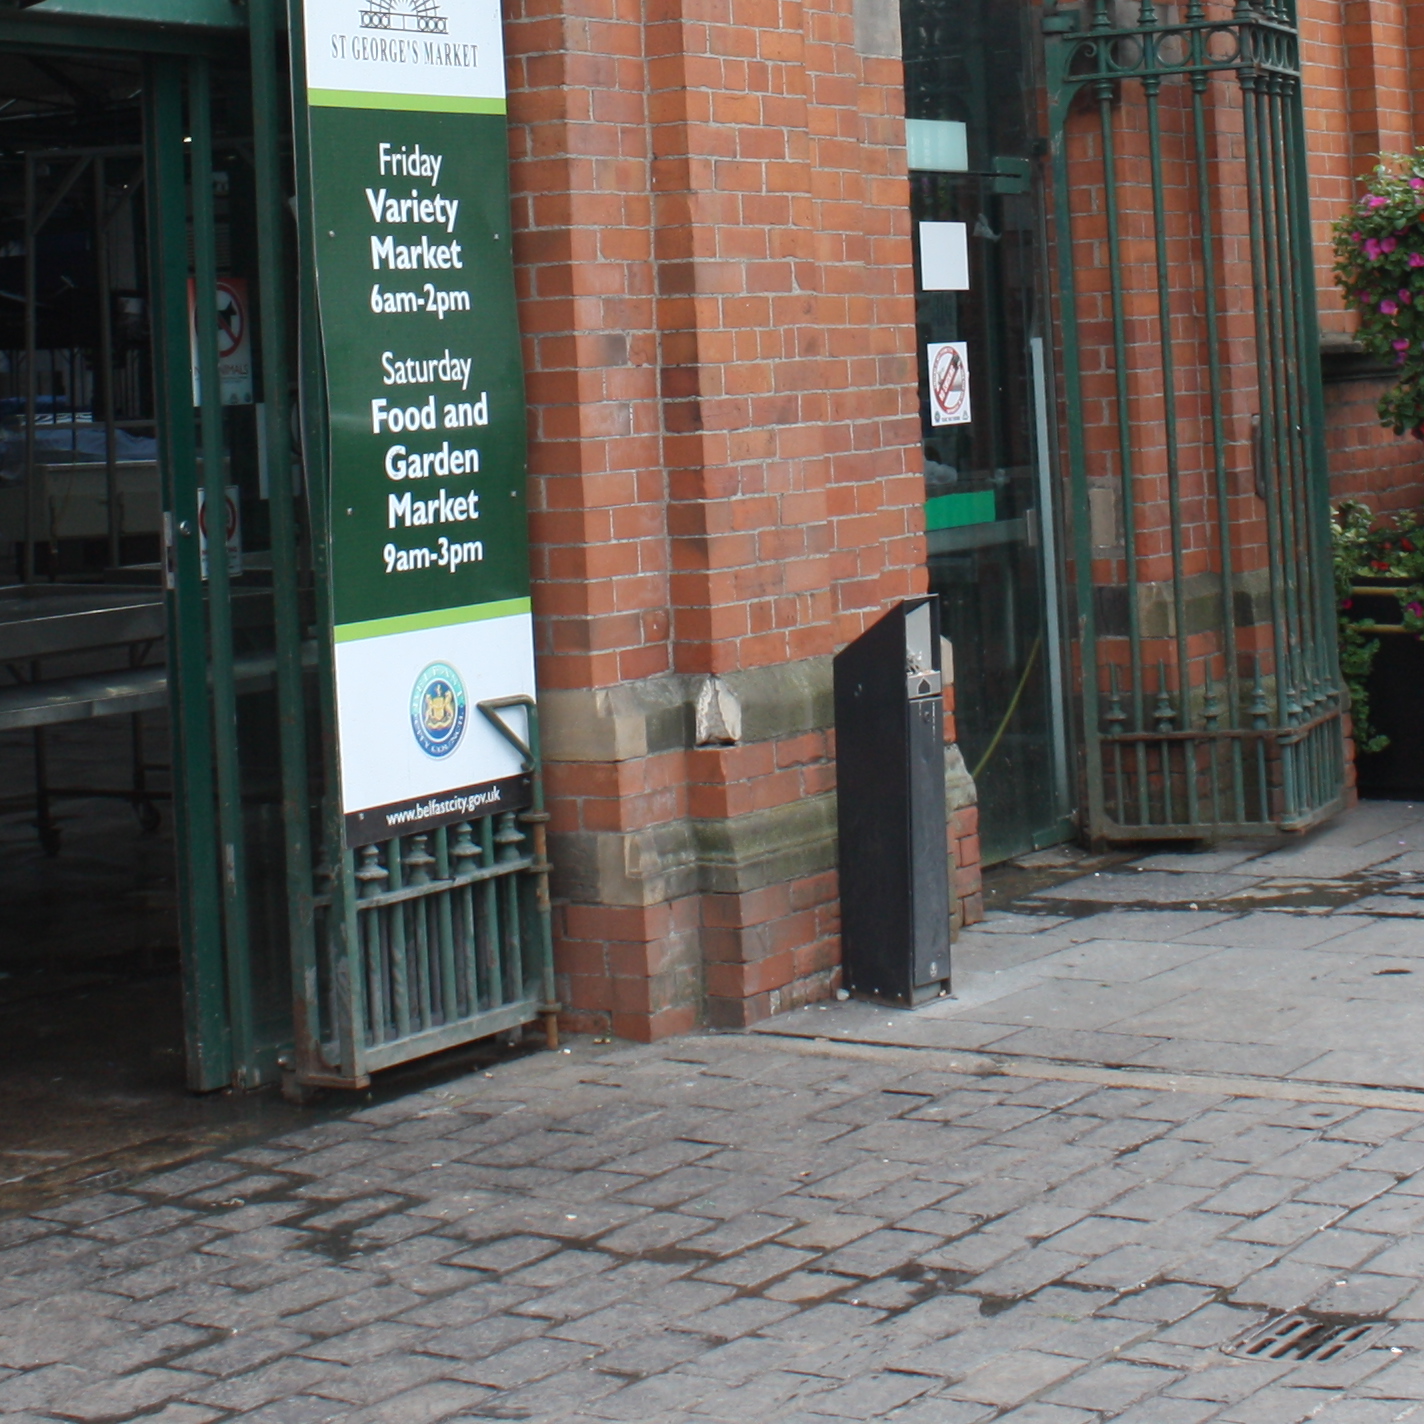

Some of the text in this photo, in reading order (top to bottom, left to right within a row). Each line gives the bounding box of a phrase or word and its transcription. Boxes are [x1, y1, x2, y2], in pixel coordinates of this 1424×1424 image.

[332, 34, 478, 68] ST GEORGE'S MARKET
[379, 143, 442, 186] Friday
[366, 188, 459, 232] Variety
[371, 236, 463, 269] Market
[371, 284, 471, 319] 6am-2pm
[382, 349, 472, 390] Saturday
[372, 392, 488, 433] Food and
[385, 442, 479, 481] Garden
[388, 489, 479, 528] Market
[383, 537, 483, 573] 9am-3pm
[386, 785, 501, 826] www.belfastcity.gov.uk
